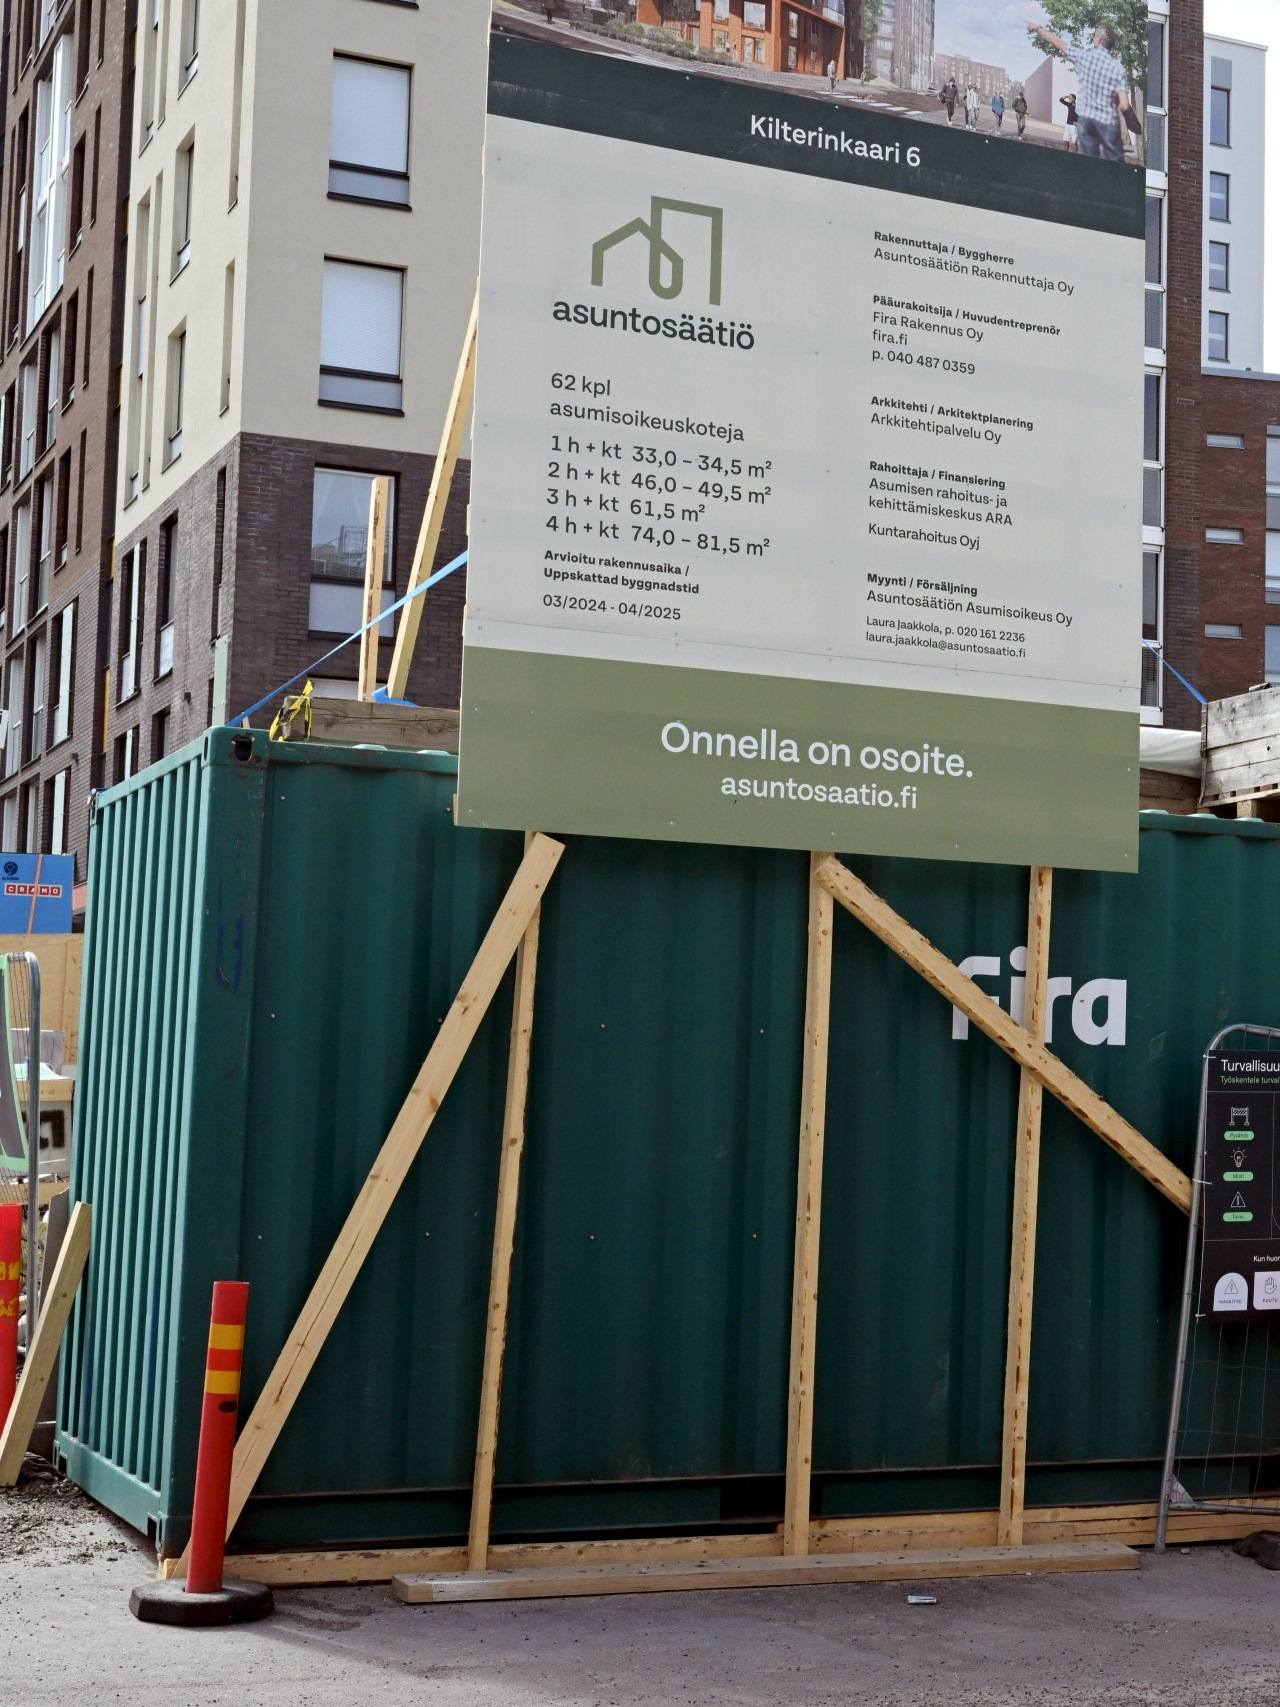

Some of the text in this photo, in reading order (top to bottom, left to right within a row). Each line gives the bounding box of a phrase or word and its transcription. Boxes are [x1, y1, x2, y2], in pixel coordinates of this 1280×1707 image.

[751, 114, 920, 166] Kilterinkaari 6
[874, 230, 1014, 265] Rakennuttaja / Byggherre
[874, 247, 1074, 296] Asuntosäätiön Rakennuttaja Oy
[552, 301, 754, 350] asuntosäätiö
[873, 294, 1060, 335] Pääurakoitsija / Huvudentreprenör
[873, 311, 983, 342] Fira Rakennus Oy
[872, 328, 907, 345] fira.fi
[872, 350, 975, 374] p. 040 487 0359
[551, 372, 610, 398] 62 kpl
[550, 403, 744, 443] asumisoikeuskoteja
[871, 396, 1033, 431] Arkkitehti / Arkitektplanering
[871, 412, 1001, 444] Arkkitehtipalvelu Oy
[551, 435, 561, 451] 1
[568, 436, 579, 453] h
[586, 442, 595, 452] +
[602, 440, 621, 459] kt
[632, 446, 676, 467] 33,0
[698, 454, 741, 476] 34,5
[548, 461, 559, 478] 2
[566, 462, 577, 480] h
[584, 469, 593, 479] +
[600, 467, 620, 486] kt
[631, 472, 676, 494] 46,0
[698, 481, 742, 502] 49,5
[869, 461, 1005, 490] Rahoittaja / Finansiering
[547, 488, 558, 504] 3
[565, 489, 576, 507] h
[583, 496, 592, 505] +
[599, 493, 619, 512] kt
[630, 499, 674, 520] 61,5
[869, 478, 1007, 508] Asumisen rahoitus- ja
[869, 495, 1012, 525] kehittämiskeskus ARA
[546, 515, 559, 531] 4
[565, 516, 576, 534] h
[583, 522, 592, 532] +
[599, 520, 619, 539] kt
[631, 525, 674, 547] 74,0
[697, 533, 740, 554] 81,5
[868, 523, 979, 550] Kuntarahoitus Oyj
[544, 550, 689, 576] Arvioitu rakennusaika /
[544, 567, 699, 594] Uppskattad byggnadstid
[867, 573, 977, 597] Myynti / Försäljning
[543, 594, 607, 612] 03/2024
[618, 602, 680, 620] 04/2025
[866, 590, 1072, 627] Asuntosäätiön Asumisoikeus Oy
[866, 616, 1025, 642] Laura Jaakkola, p. 020 161 2236
[866, 631, 1025, 657] laura.jaakkola@asuntosaatio.fi
[661, 720, 972, 778] Onnella on osoite.
[721, 777, 917, 809] asuntosaatio.fi
[1220, 1075, 1259, 1084] Työskentele
